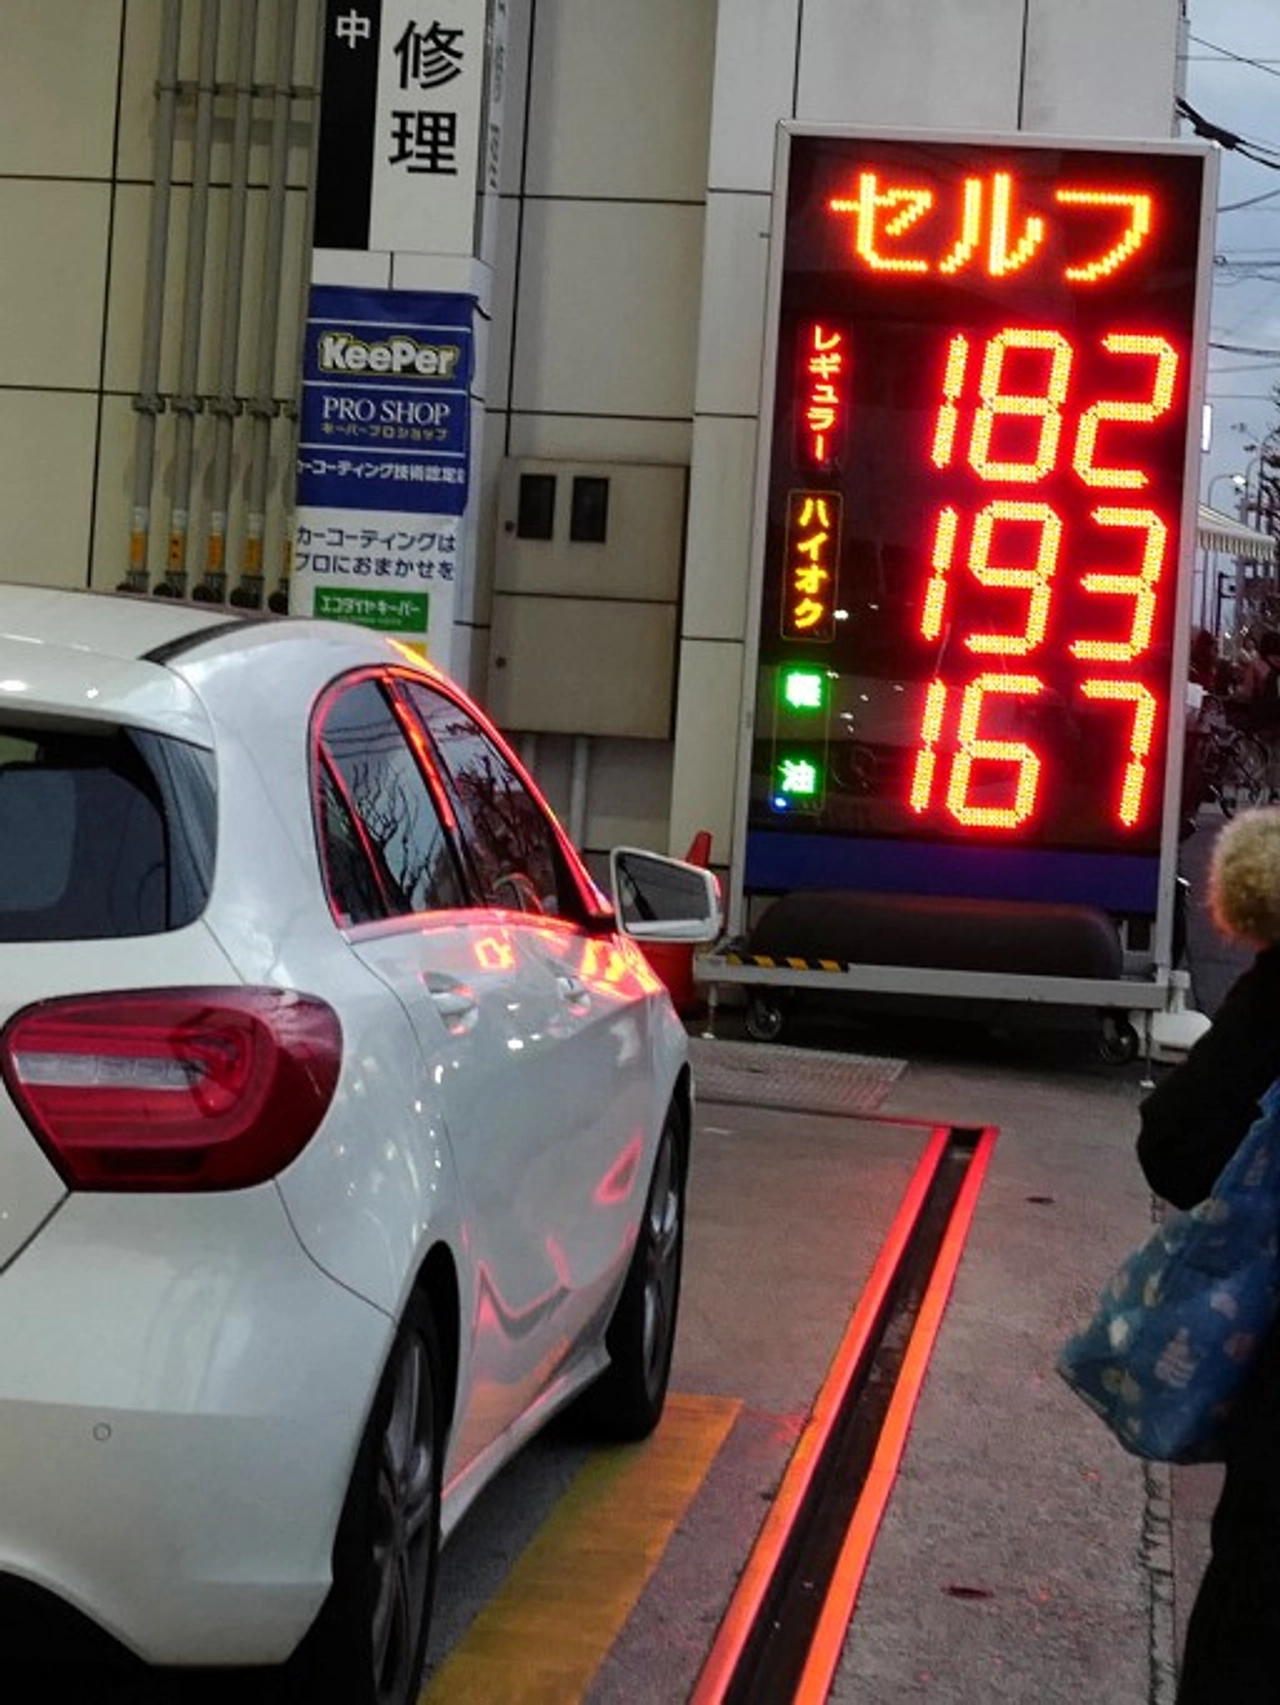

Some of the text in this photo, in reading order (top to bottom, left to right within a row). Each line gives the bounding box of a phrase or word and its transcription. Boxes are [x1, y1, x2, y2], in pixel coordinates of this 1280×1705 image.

[336, 8, 371, 49] 中
[388, 19, 464, 176] 修理
[830, 172, 1152, 282] セルフ
[320, 334, 457, 376] KeePer
[322, 395, 450, 426] PRO SHOP
[807, 324, 842, 462] レギュラー
[931, 327, 1180, 489] 182
[321, 422, 449, 441] キーパープロショップ
[298, 459, 466, 484] ーコーティング技術認定
[296, 525, 457, 553] カーコーティングは
[294, 552, 455, 581] プロにおまかせを
[795, 498, 830, 629] ハイオク
[921, 499, 1169, 662] 193
[320, 594, 422, 618] エコダイヤキーパー
[910, 673, 1158, 829] 167
